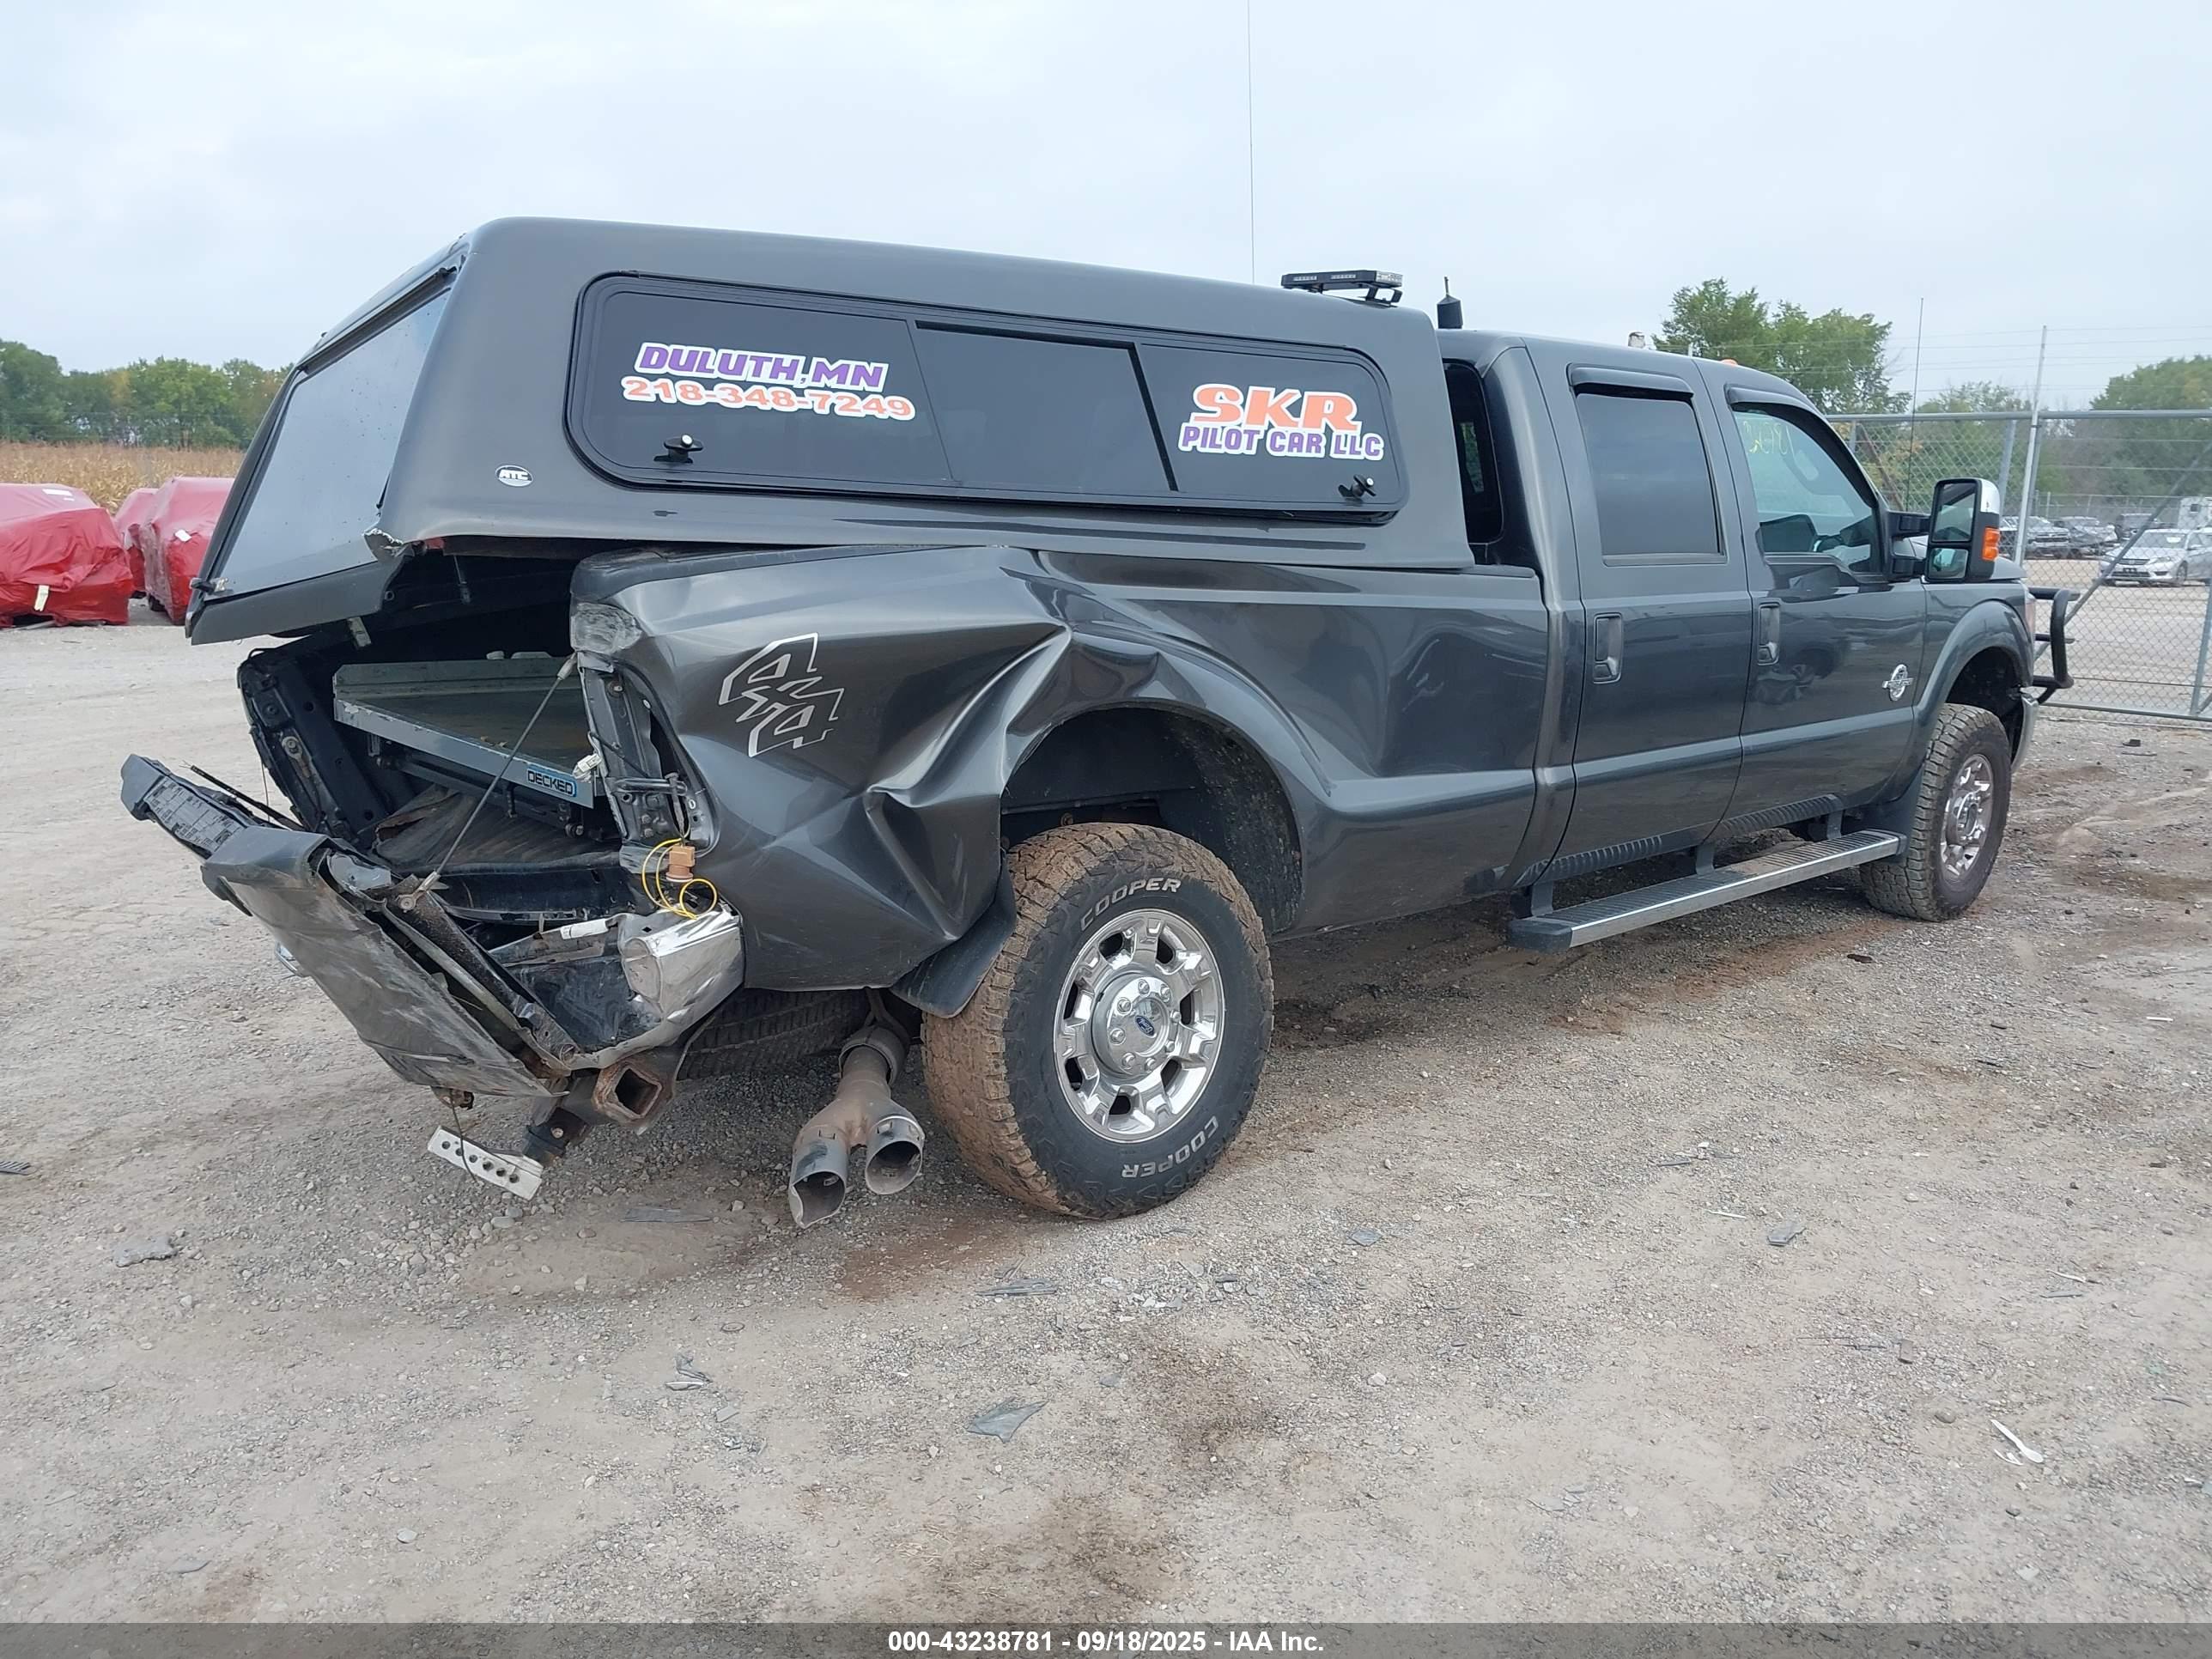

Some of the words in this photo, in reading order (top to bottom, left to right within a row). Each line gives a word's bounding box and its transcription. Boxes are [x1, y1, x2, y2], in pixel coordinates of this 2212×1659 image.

[623, 378, 914, 418] 218-348-7249
[1192, 385, 1360, 432] SKR
[1181, 424, 1261, 453] PILOT
[1268, 429, 1323, 454] CAR
[1332, 433, 1384, 459] LLC
[526, 769, 574, 795] DECKED
[1080, 877, 1182, 932] COOPER
[1121, 1115, 1219, 1179] COOPER
